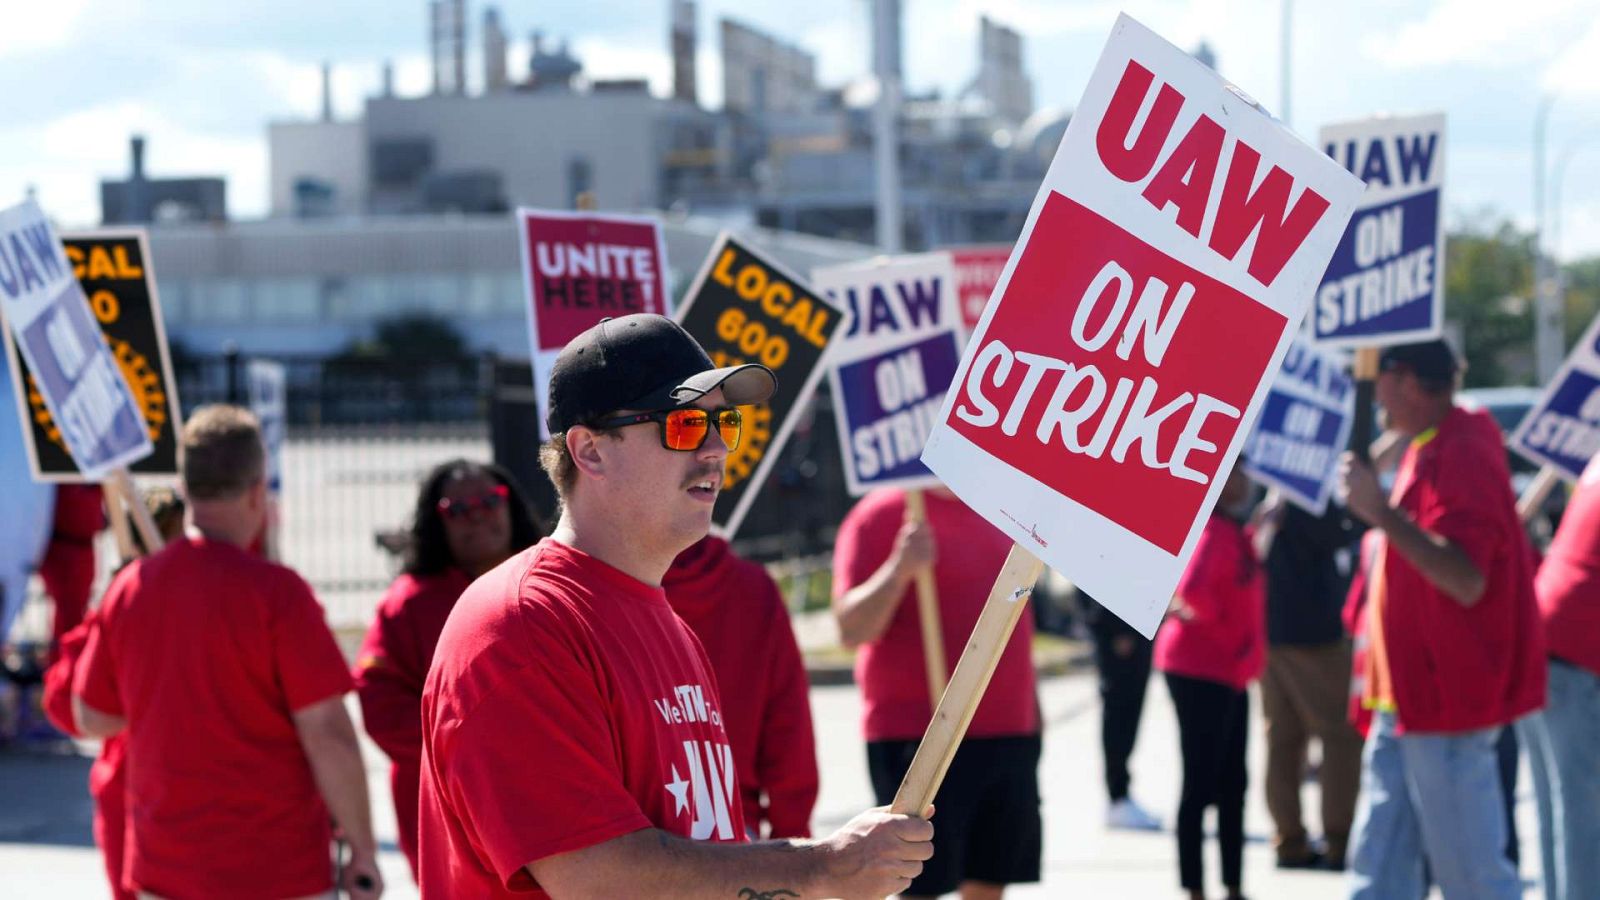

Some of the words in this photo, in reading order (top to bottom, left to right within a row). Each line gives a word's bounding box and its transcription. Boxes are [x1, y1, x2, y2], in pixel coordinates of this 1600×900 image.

[1096, 59, 1331, 288] UAW
[65, 245, 143, 279] CAL
[536, 241, 655, 280] UNITE
[1354, 206, 1404, 269] ON
[711, 249, 829, 348] LOCAL
[1070, 260, 1195, 367] ON
[1317, 244, 1434, 335] STRIKE
[716, 308, 789, 369] 600
[875, 347, 927, 414] ON
[956, 340, 1241, 485] STRIKE
[654, 698, 682, 725] We
